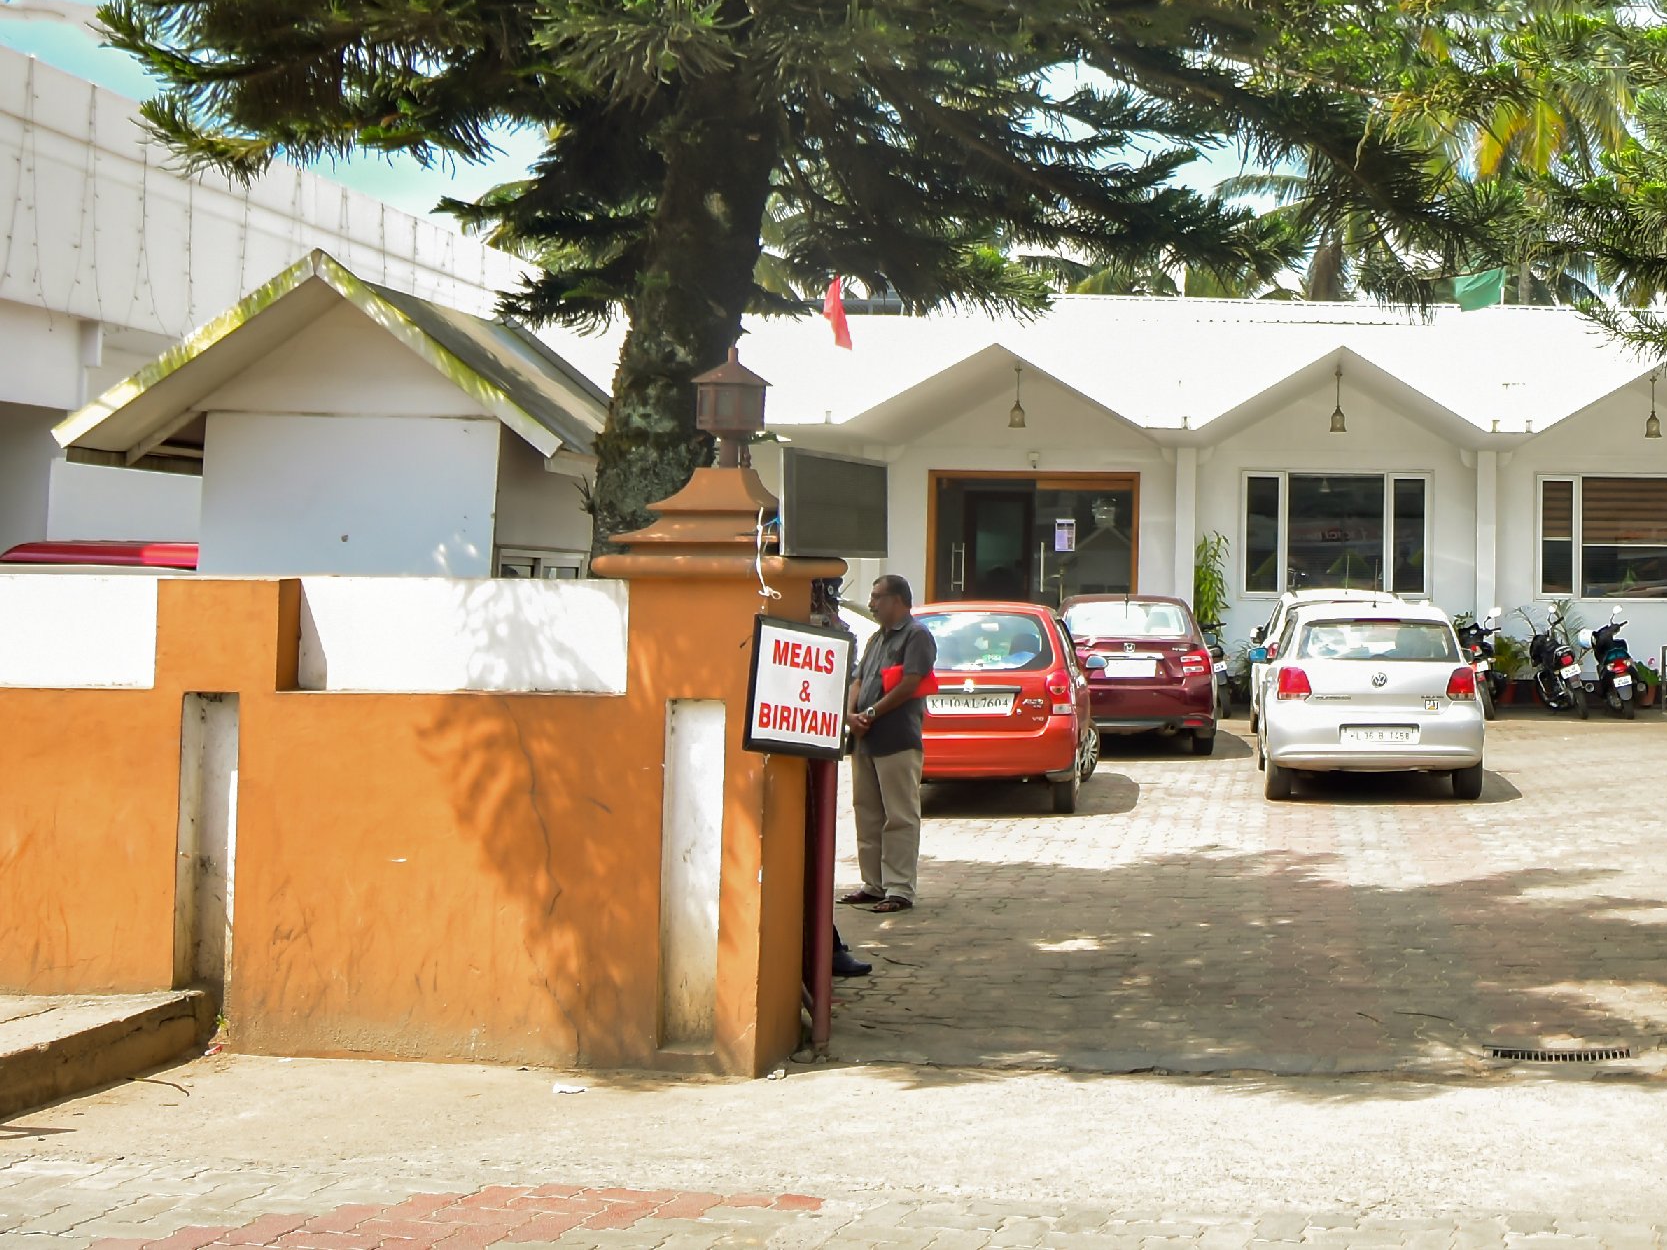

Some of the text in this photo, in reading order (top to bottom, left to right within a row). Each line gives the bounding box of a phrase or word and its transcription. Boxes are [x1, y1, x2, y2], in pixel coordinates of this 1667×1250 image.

[772, 639, 836, 675] MEALS
[799, 680, 811, 703] &
[758, 702, 838, 738] BIRIYANI
